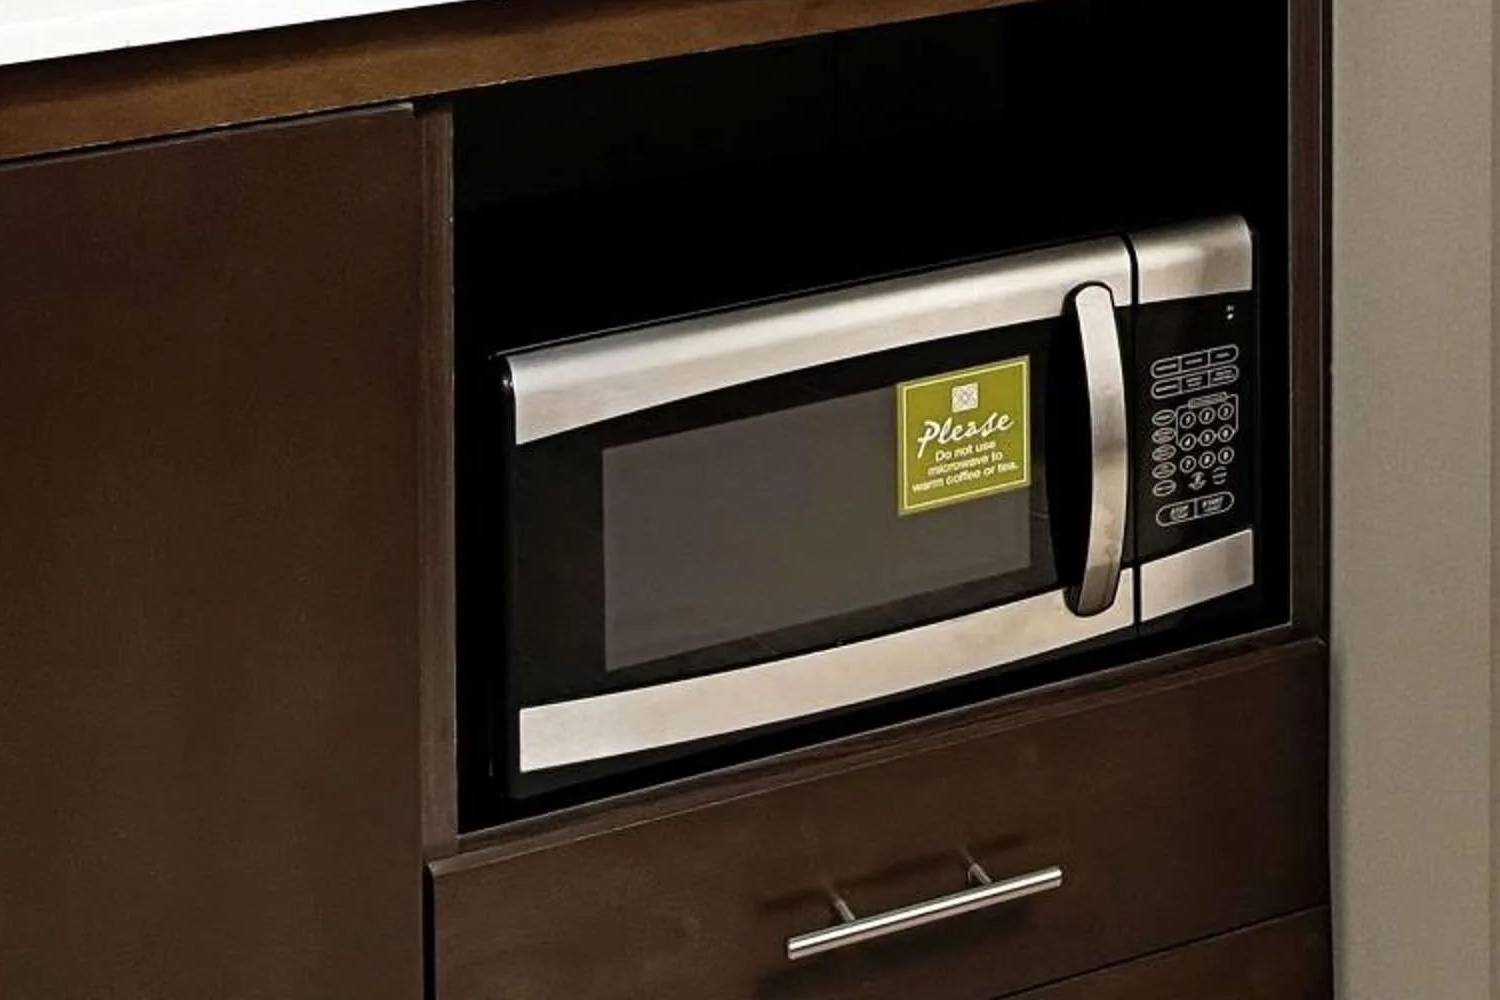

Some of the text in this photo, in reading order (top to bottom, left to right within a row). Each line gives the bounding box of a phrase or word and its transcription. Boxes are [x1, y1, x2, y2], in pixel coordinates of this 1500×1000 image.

[917, 412, 1014, 459] Please
[927, 451, 1003, 477] microwave to
[936, 441, 997, 461] Do not use
[912, 478, 944, 492] warm
[946, 470, 980, 485] coffee
[984, 466, 995, 476] or
